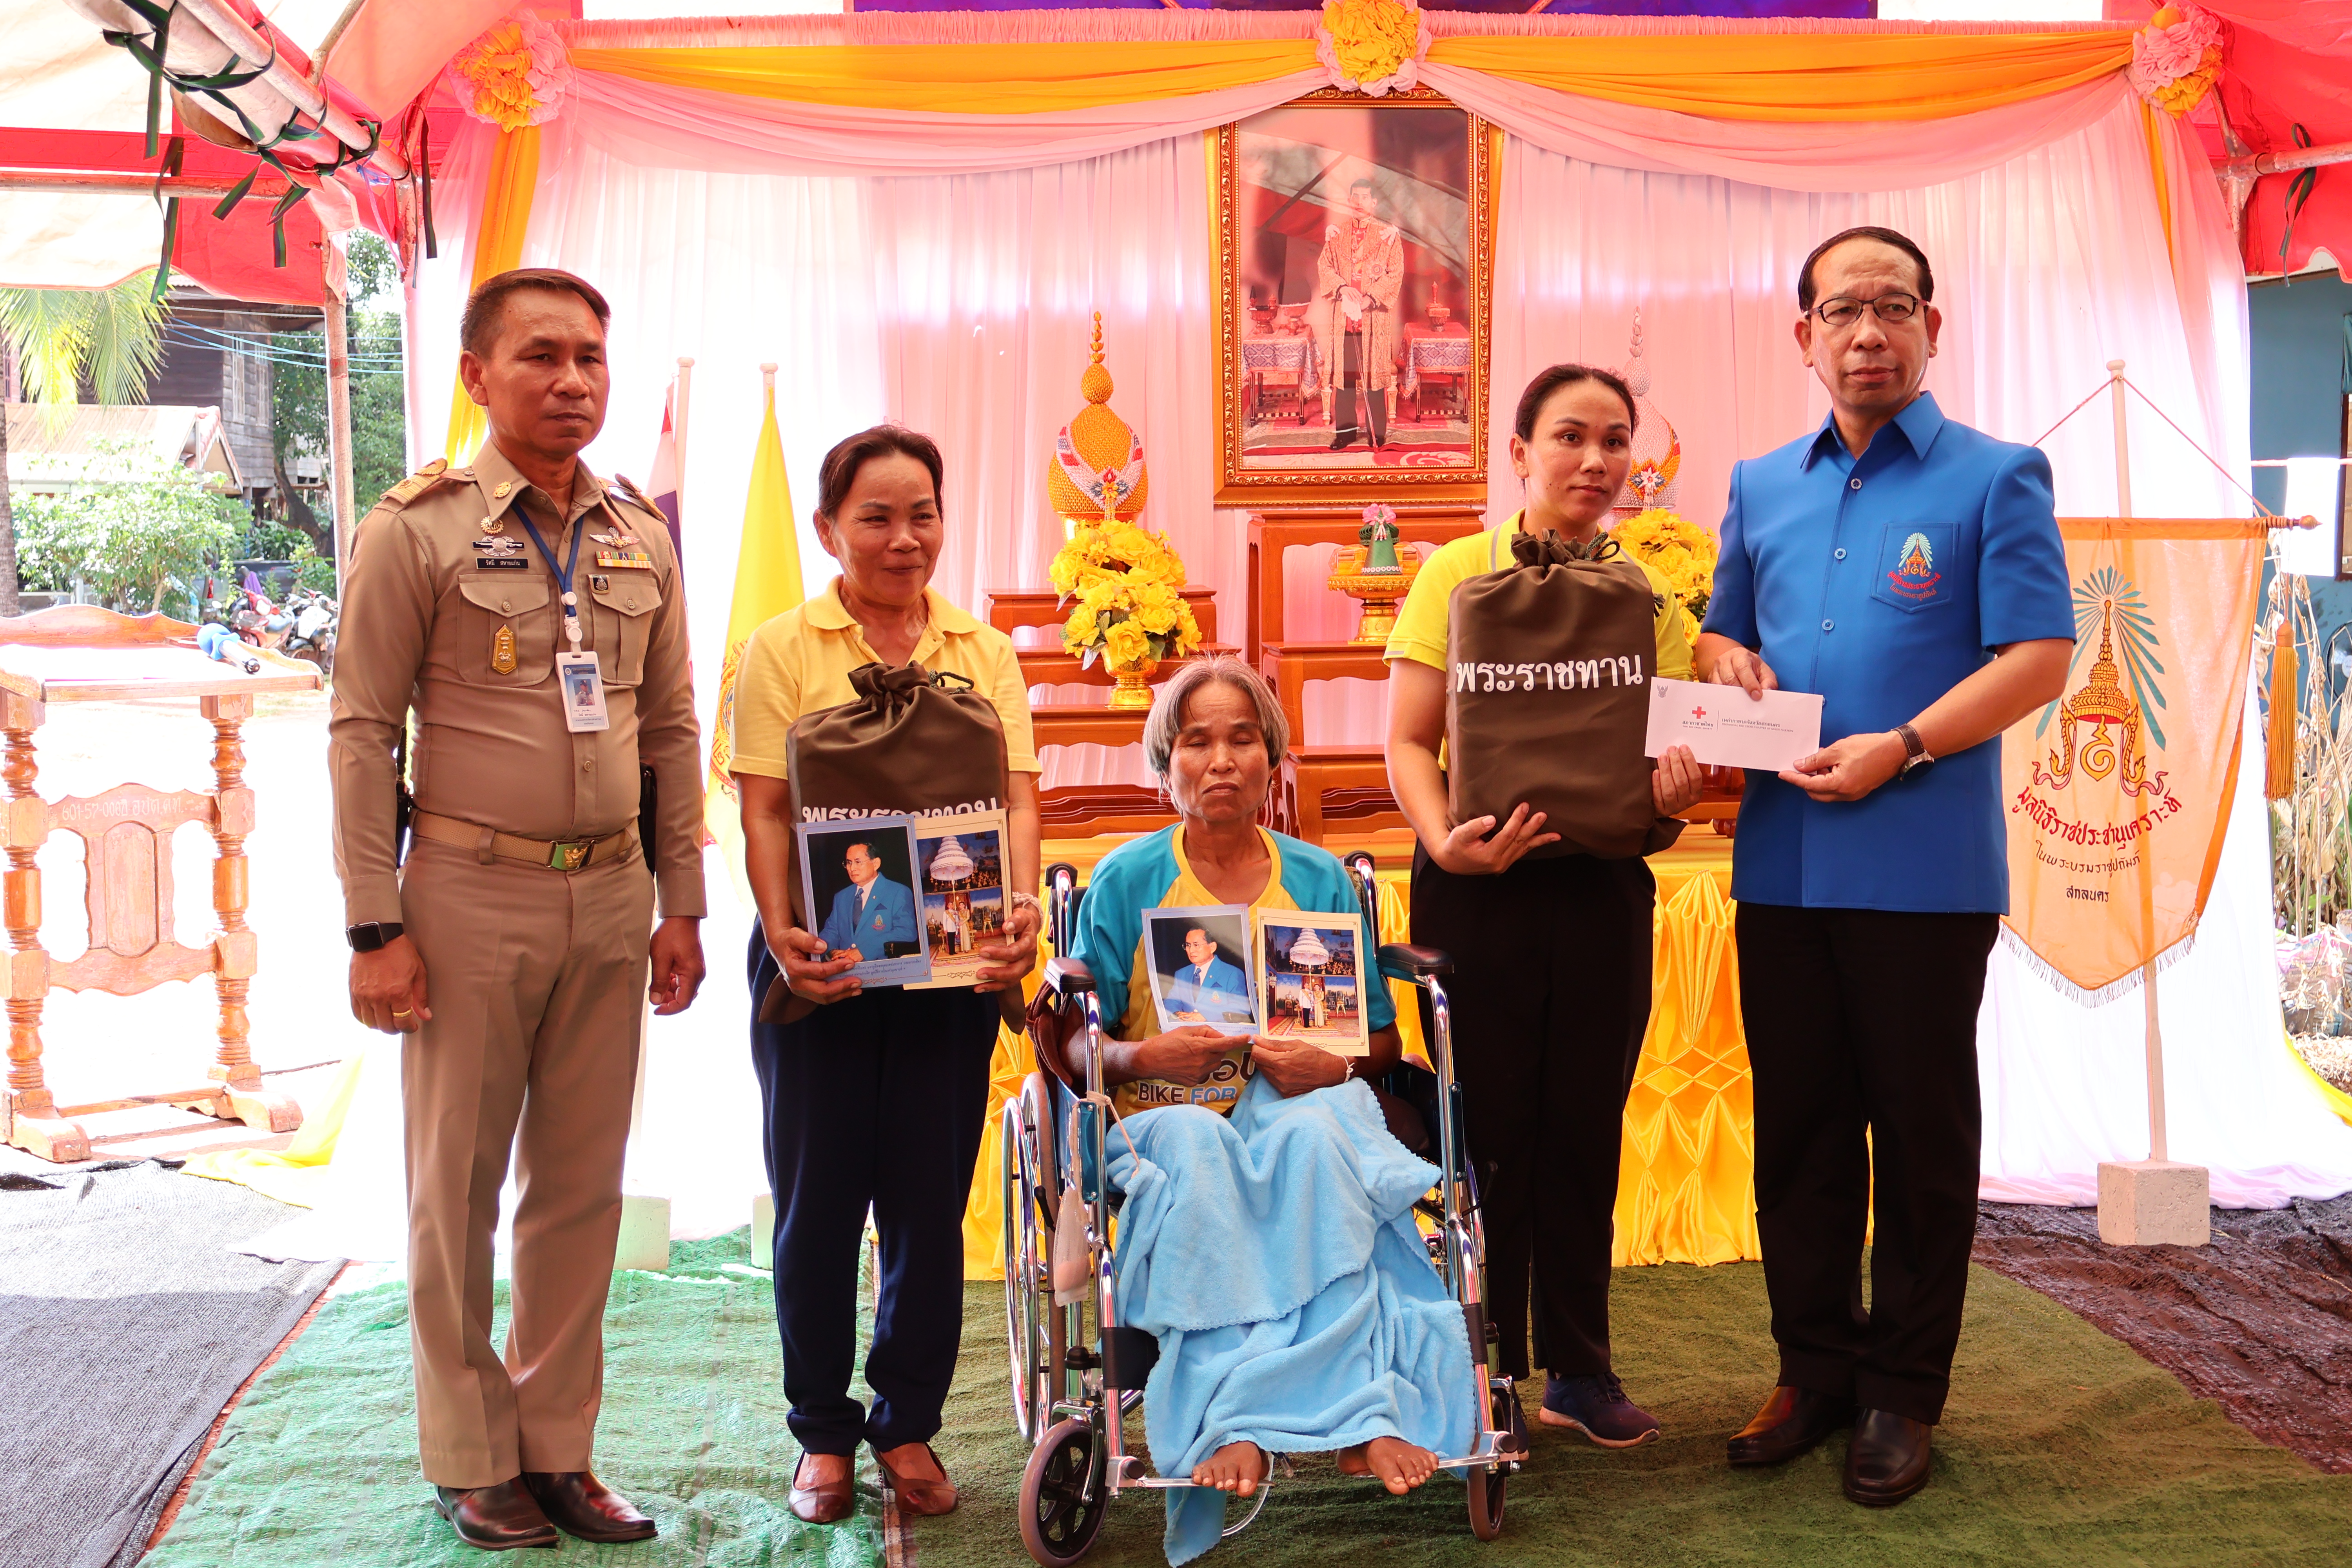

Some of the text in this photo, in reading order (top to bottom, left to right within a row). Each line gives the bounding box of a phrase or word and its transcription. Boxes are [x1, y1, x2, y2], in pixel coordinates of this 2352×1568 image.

[1455, 654, 1644, 693] พระราชทาน
[2012, 786, 2182, 851] มูลนิธิราชประชานุเคราะห์
[2035, 840, 2140, 878] ในพระบรมราชูปถัมภ์
[2066, 885, 2110, 902] สกลนคร
[1138, 1082, 1237, 1104] BIKE FOR
